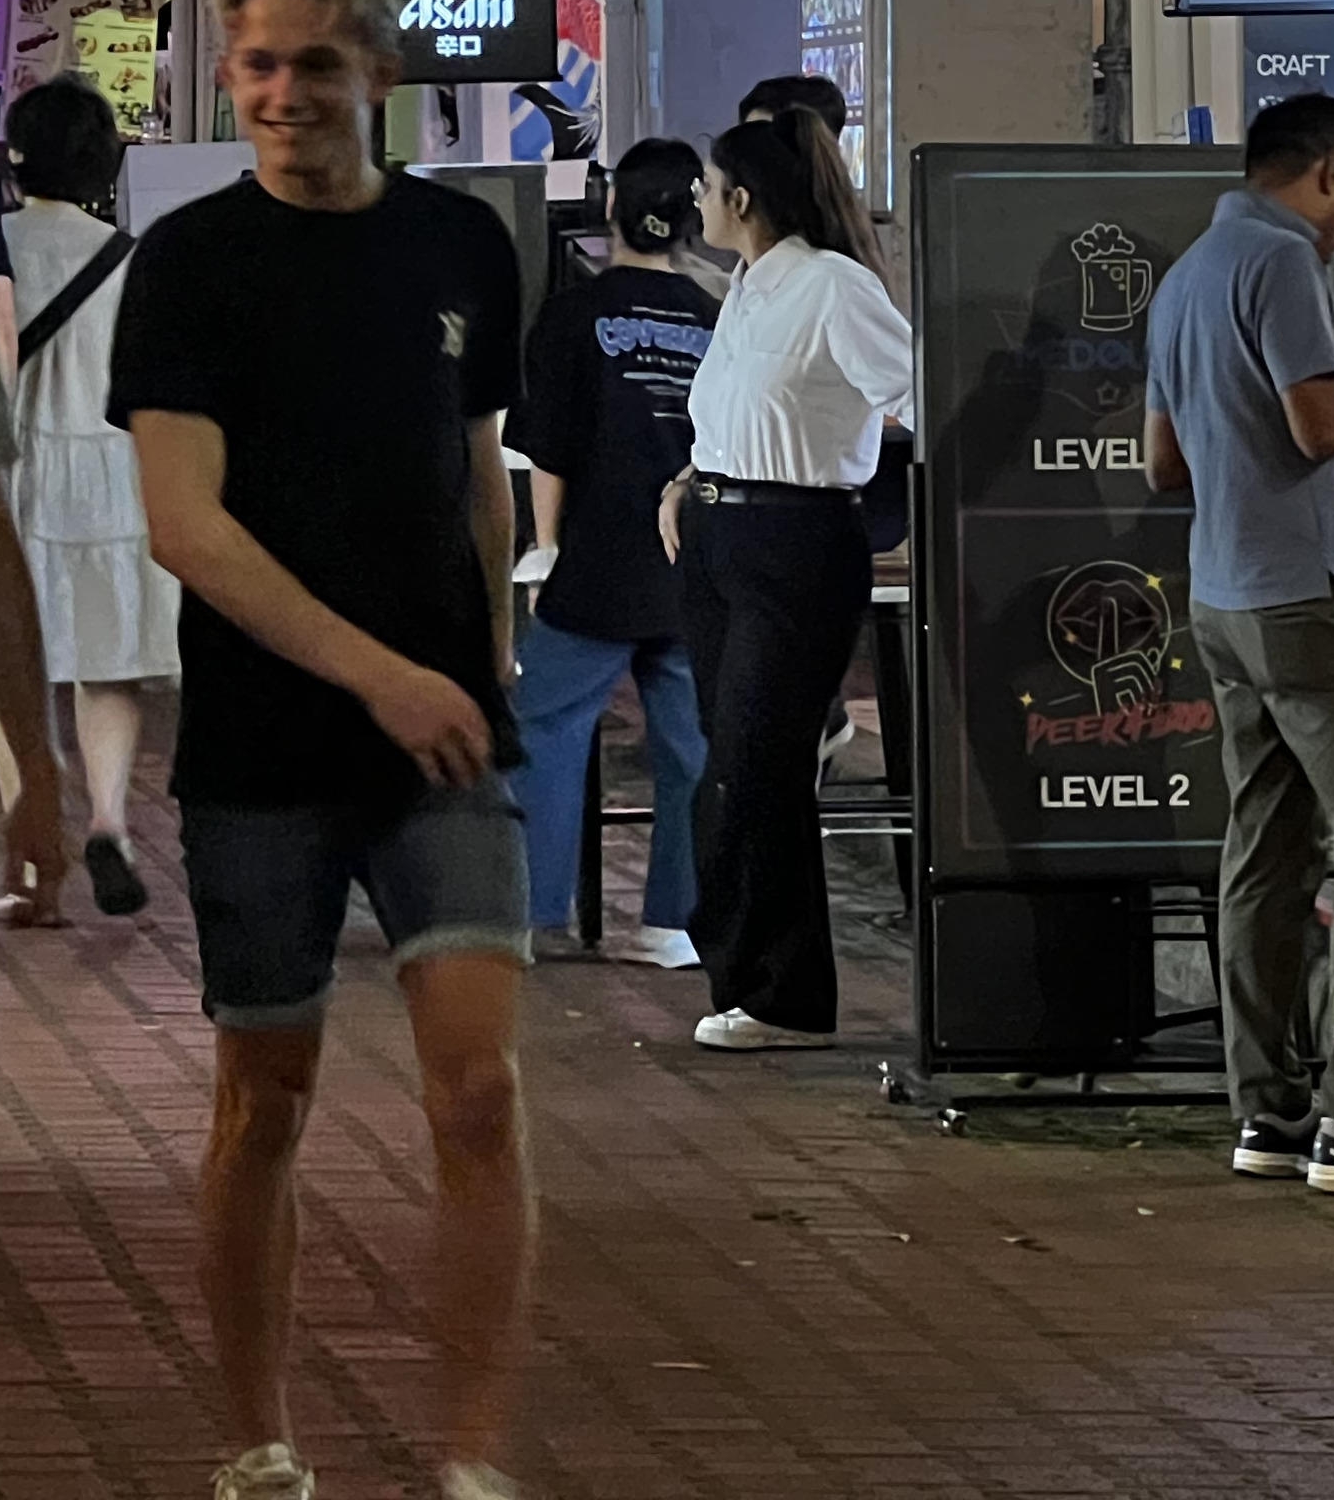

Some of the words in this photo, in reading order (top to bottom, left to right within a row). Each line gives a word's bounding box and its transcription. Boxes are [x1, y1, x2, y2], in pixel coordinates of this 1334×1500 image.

[435, 33, 483, 58] 辛口
[1257, 54, 1330, 77] CRAFT
[1033, 437, 1145, 470] LEVEL
[1040, 775, 1160, 808] LEVEL
[1168, 773, 1191, 807] 2
